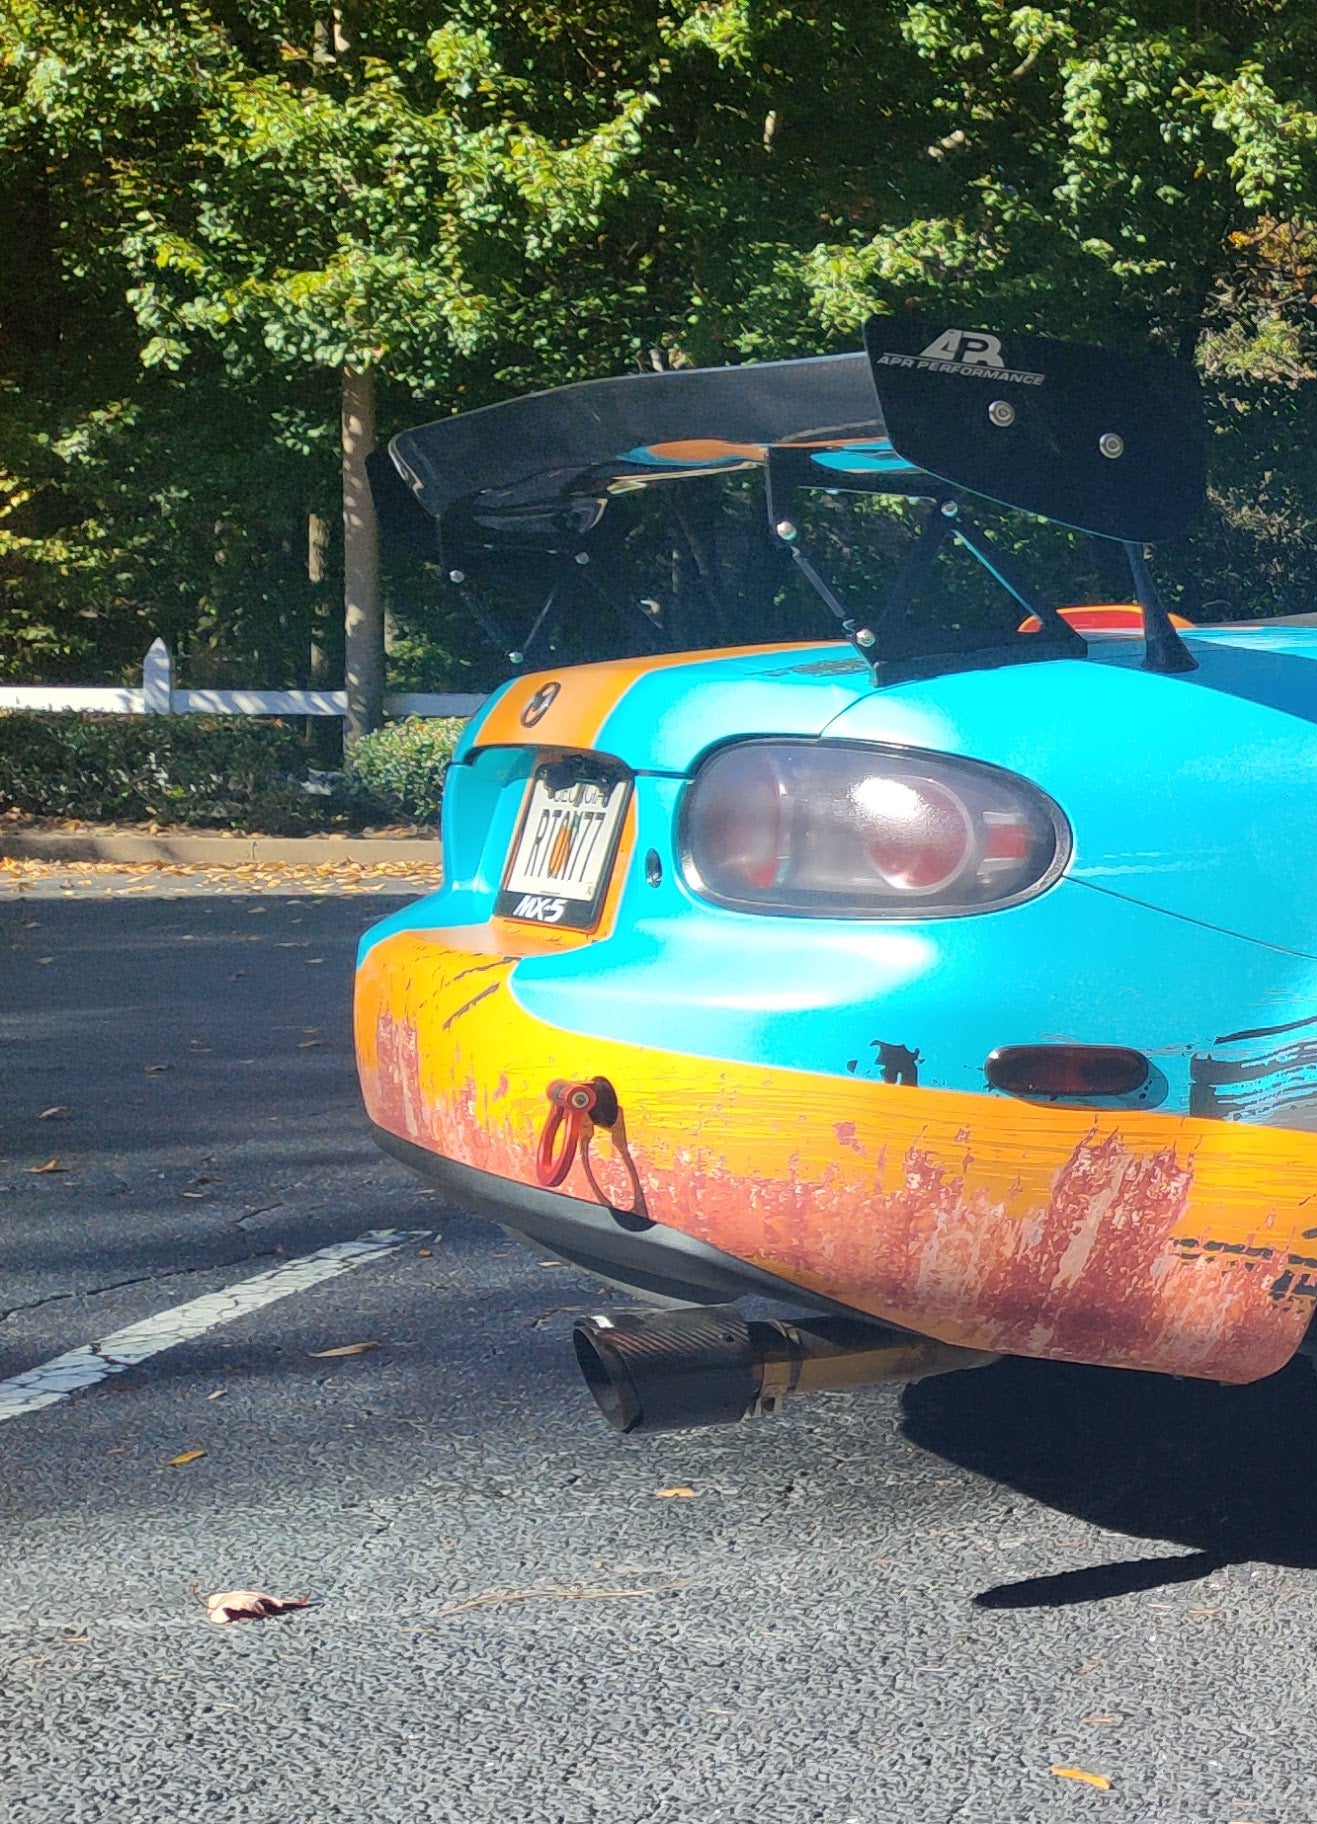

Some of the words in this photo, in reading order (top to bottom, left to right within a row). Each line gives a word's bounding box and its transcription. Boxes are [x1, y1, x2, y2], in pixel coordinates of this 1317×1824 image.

[876, 355, 914, 369] APR
[916, 360, 1046, 387] PERFORMANCE
[512, 894, 569, 923] MX-5
